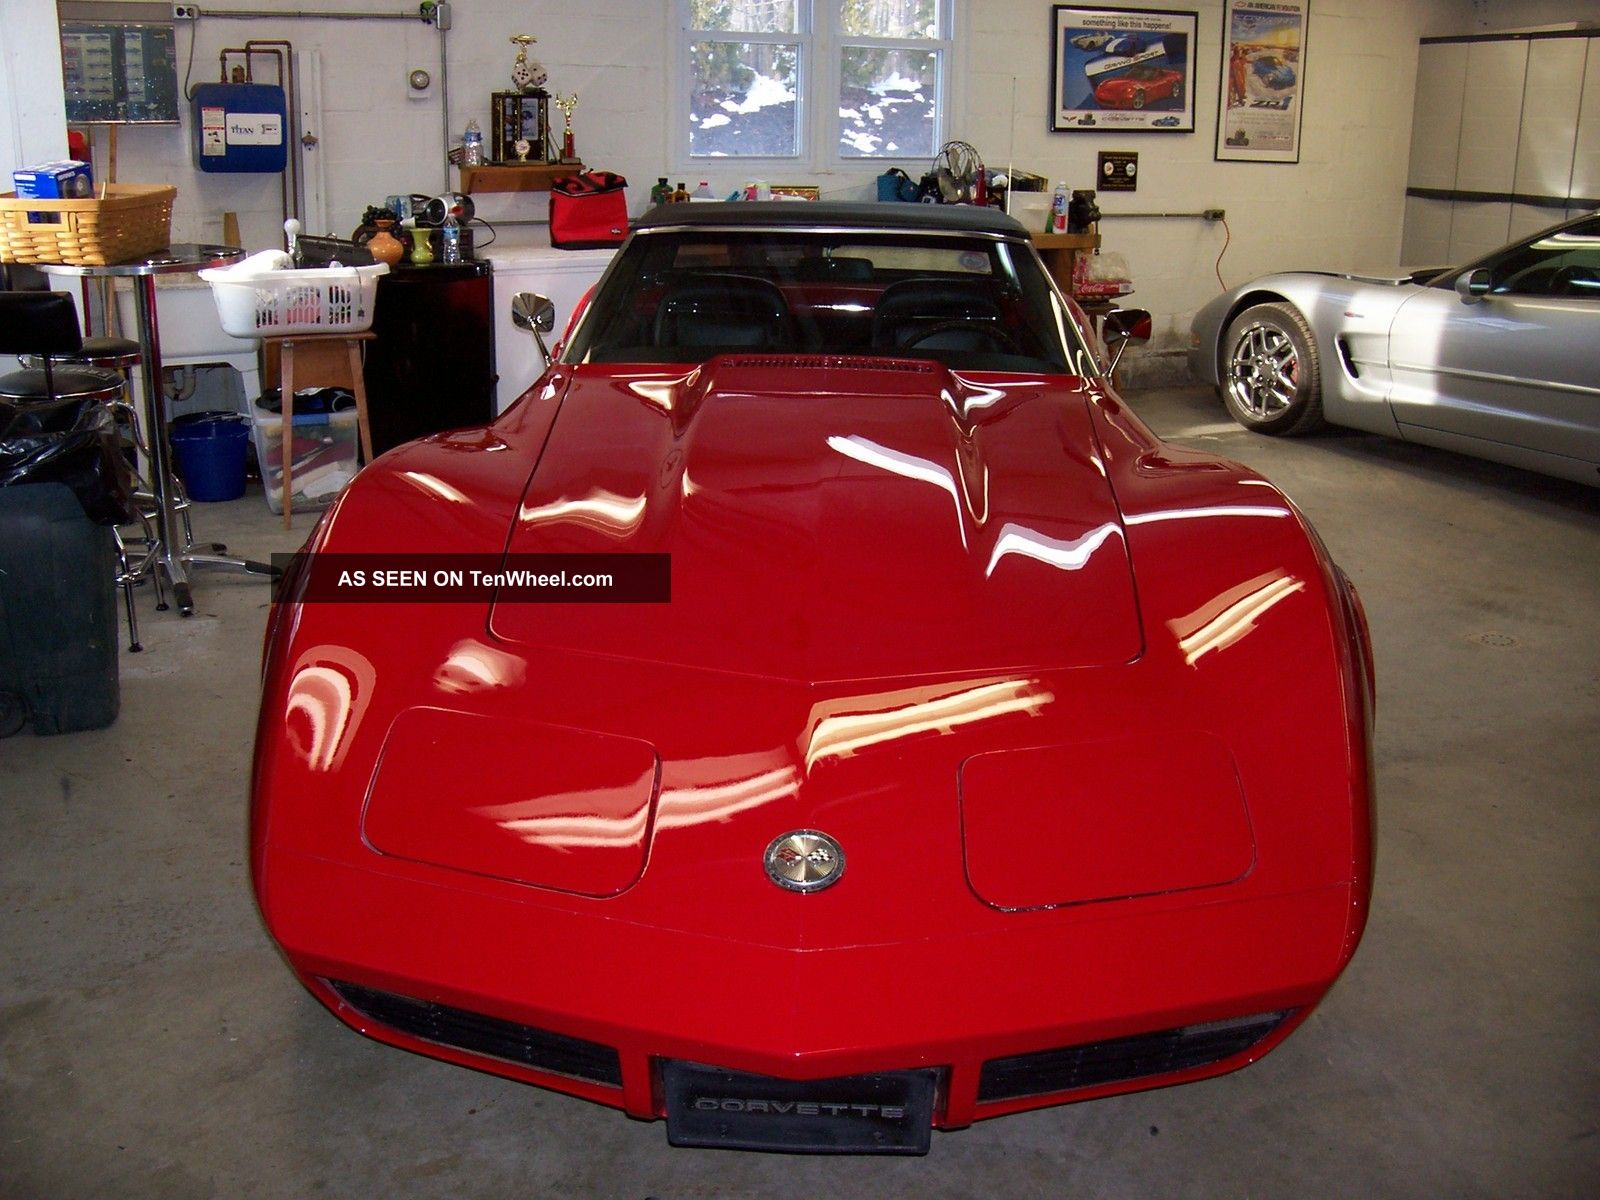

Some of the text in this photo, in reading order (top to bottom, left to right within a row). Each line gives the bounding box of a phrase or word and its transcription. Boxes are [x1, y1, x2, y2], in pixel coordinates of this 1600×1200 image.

[1082, 18, 1172, 31] something like this happens!
[230, 124, 254, 135] TITAN
[694, 1097, 905, 1119] CORVETTE
